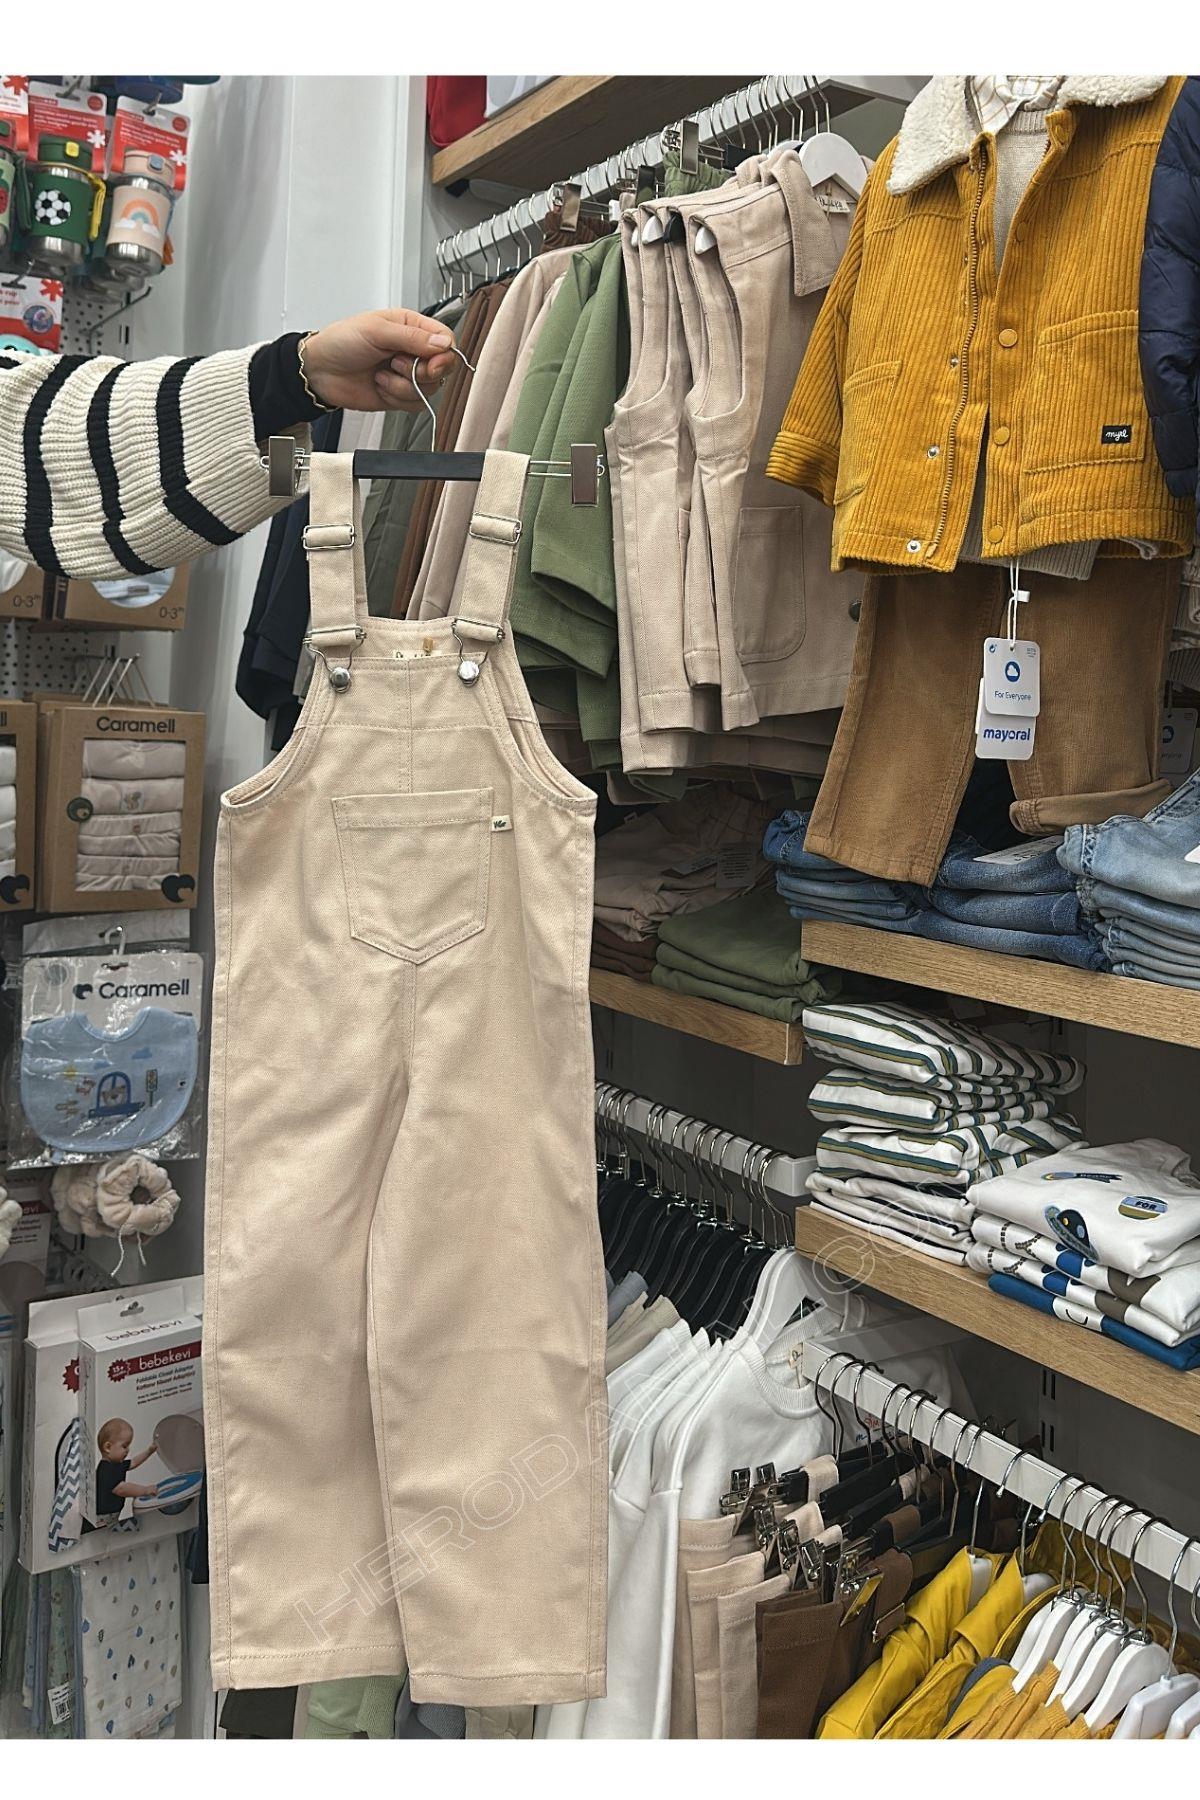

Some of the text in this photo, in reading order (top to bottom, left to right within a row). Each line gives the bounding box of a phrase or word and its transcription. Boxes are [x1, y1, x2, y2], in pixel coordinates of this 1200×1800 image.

[994, 690, 1032, 702] For Everyone
[96, 716, 175, 733] Caramell
[983, 727, 1031, 743] mayoral
[98, 978, 190, 1000] Caramell
[1134, 1200, 1158, 1211] FOR
[105, 1319, 183, 1341] bebekevi
[139, 1347, 191, 1370] bebekevi
